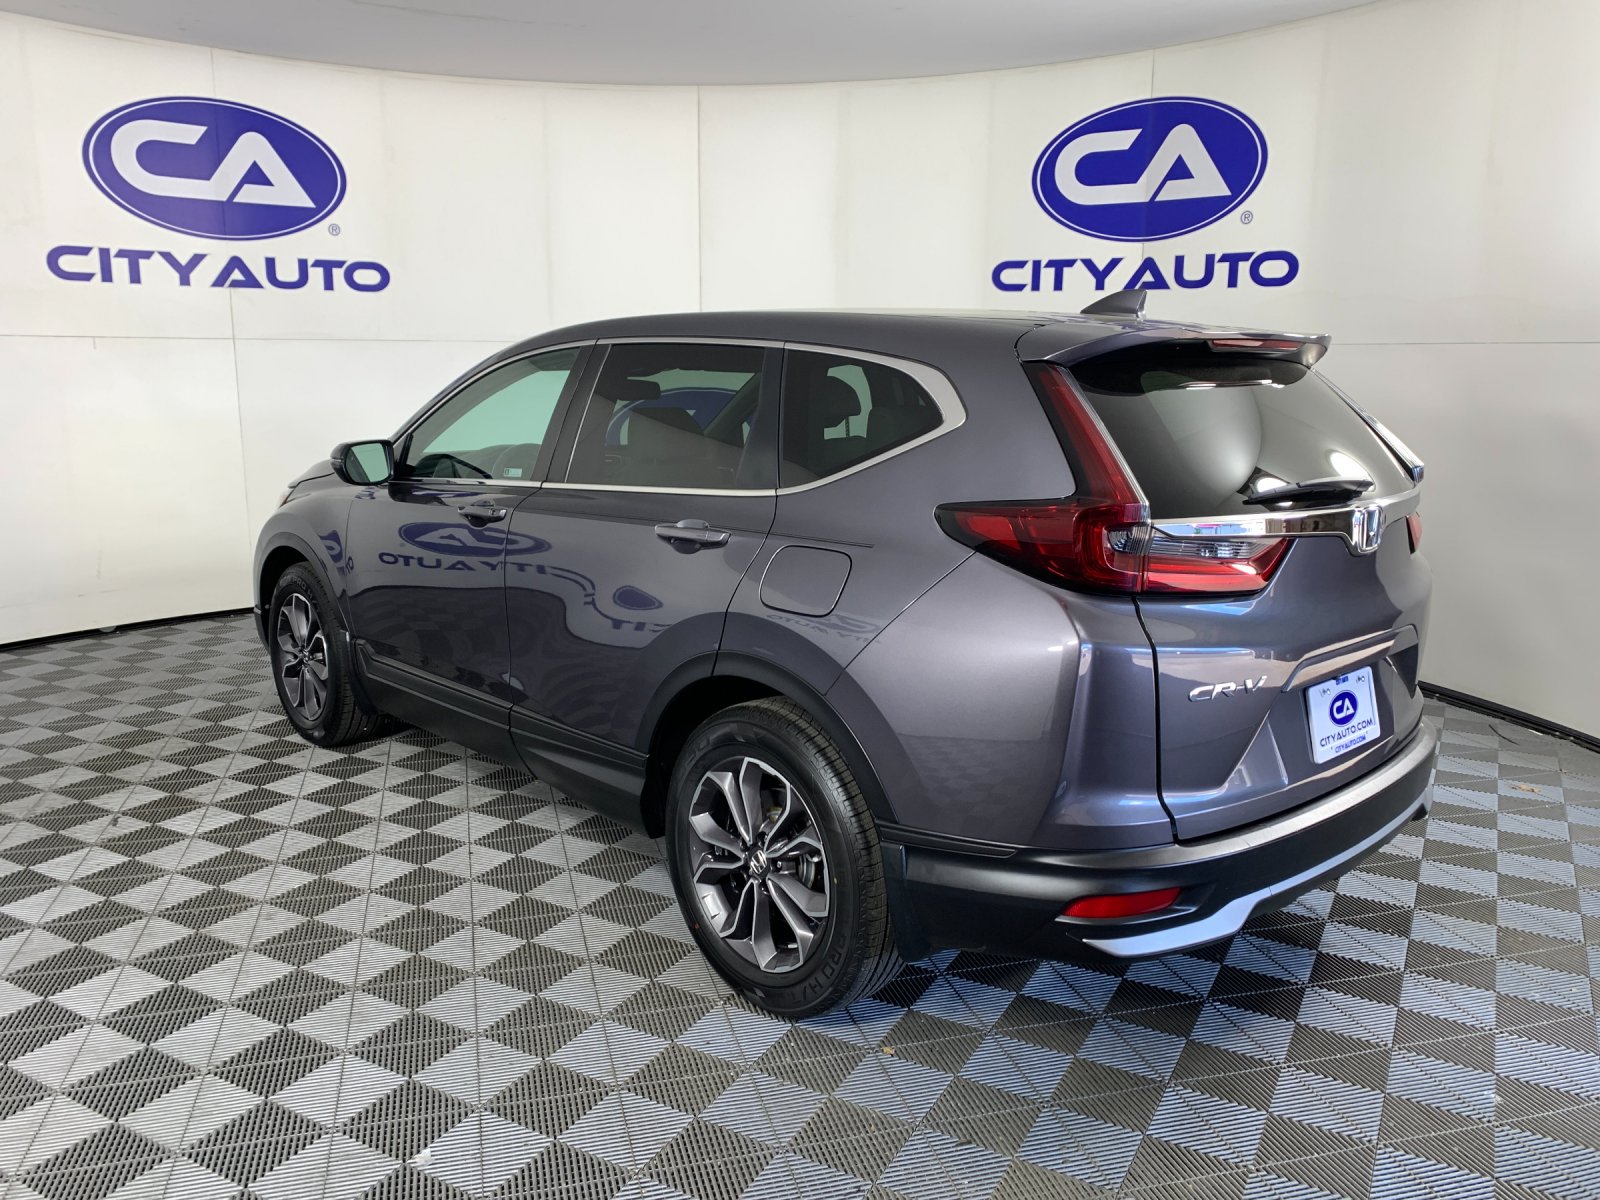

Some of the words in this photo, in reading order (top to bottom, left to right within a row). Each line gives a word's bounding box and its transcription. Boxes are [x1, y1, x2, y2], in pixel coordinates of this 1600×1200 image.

[110, 119, 316, 208] CA
[1054, 123, 1233, 206] CA
[1188, 676, 1267, 702] CR-V
[1332, 697, 1355, 720] CA
